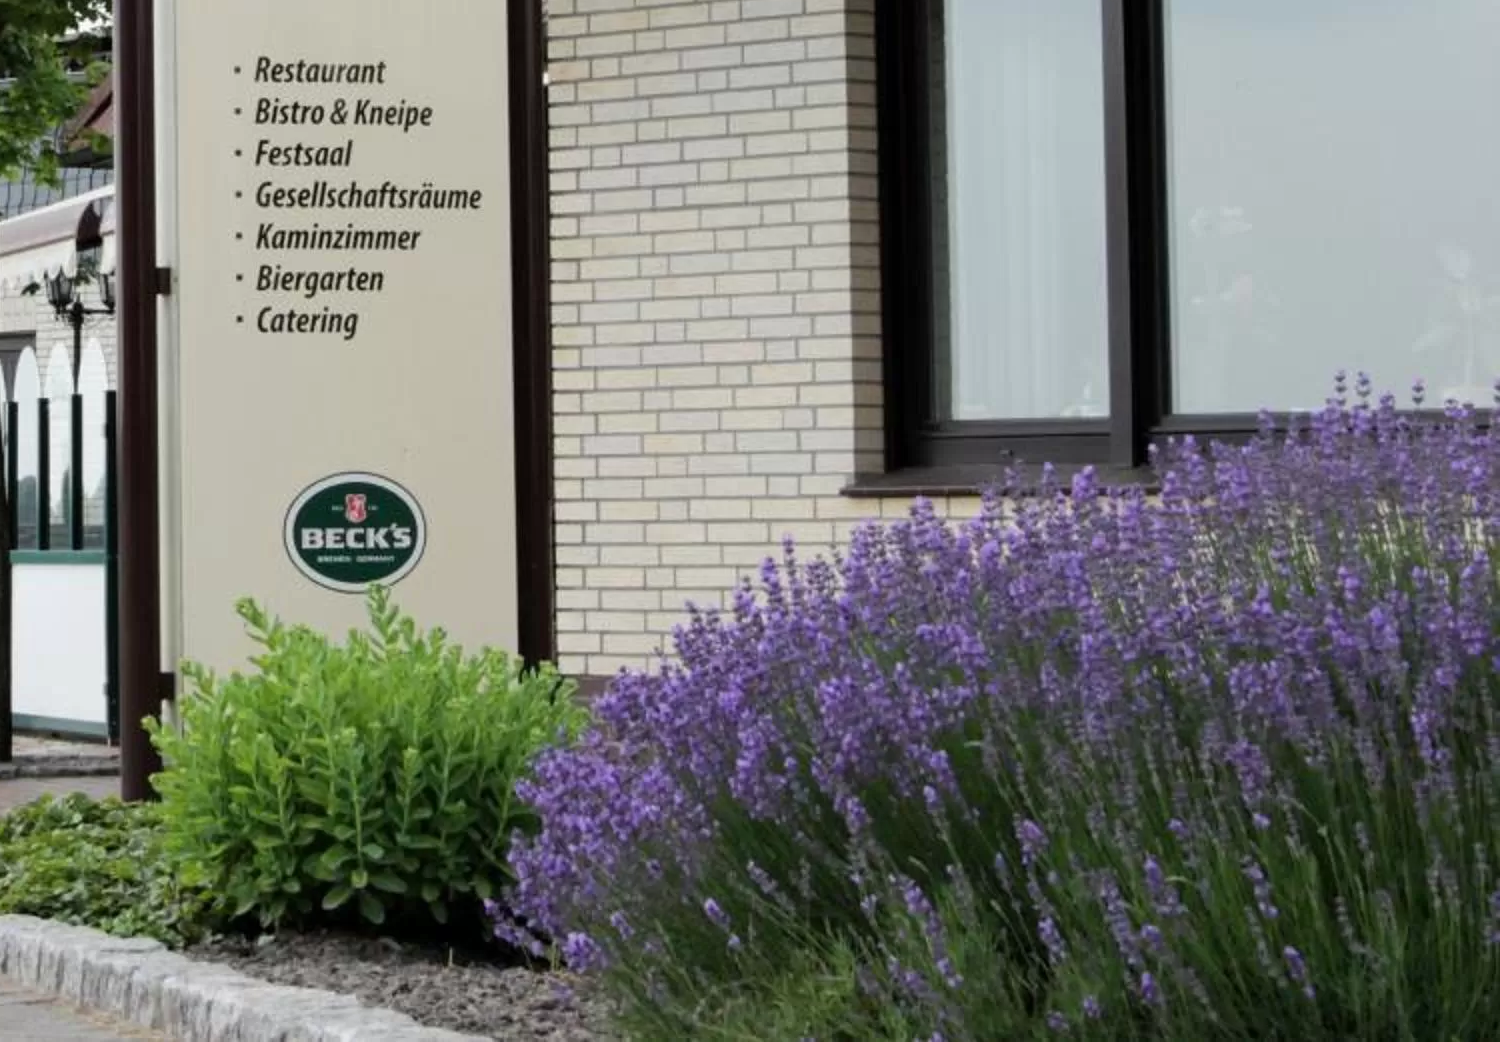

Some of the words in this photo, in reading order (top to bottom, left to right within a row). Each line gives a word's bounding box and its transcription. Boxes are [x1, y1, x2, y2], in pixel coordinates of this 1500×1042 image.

[254, 55, 387, 84] Restaurant
[254, 97, 325, 125] Bistro
[329, 97, 349, 126] &
[353, 98, 434, 133] Kneipe
[254, 139, 354, 167] Festsaal
[255, 180, 483, 210] Gesellschaftsräume
[255, 222, 422, 251] Kaminzimmer
[255, 264, 385, 299] Biergarten
[256, 306, 360, 341] Catering
[301, 522, 412, 550] BECK'S
